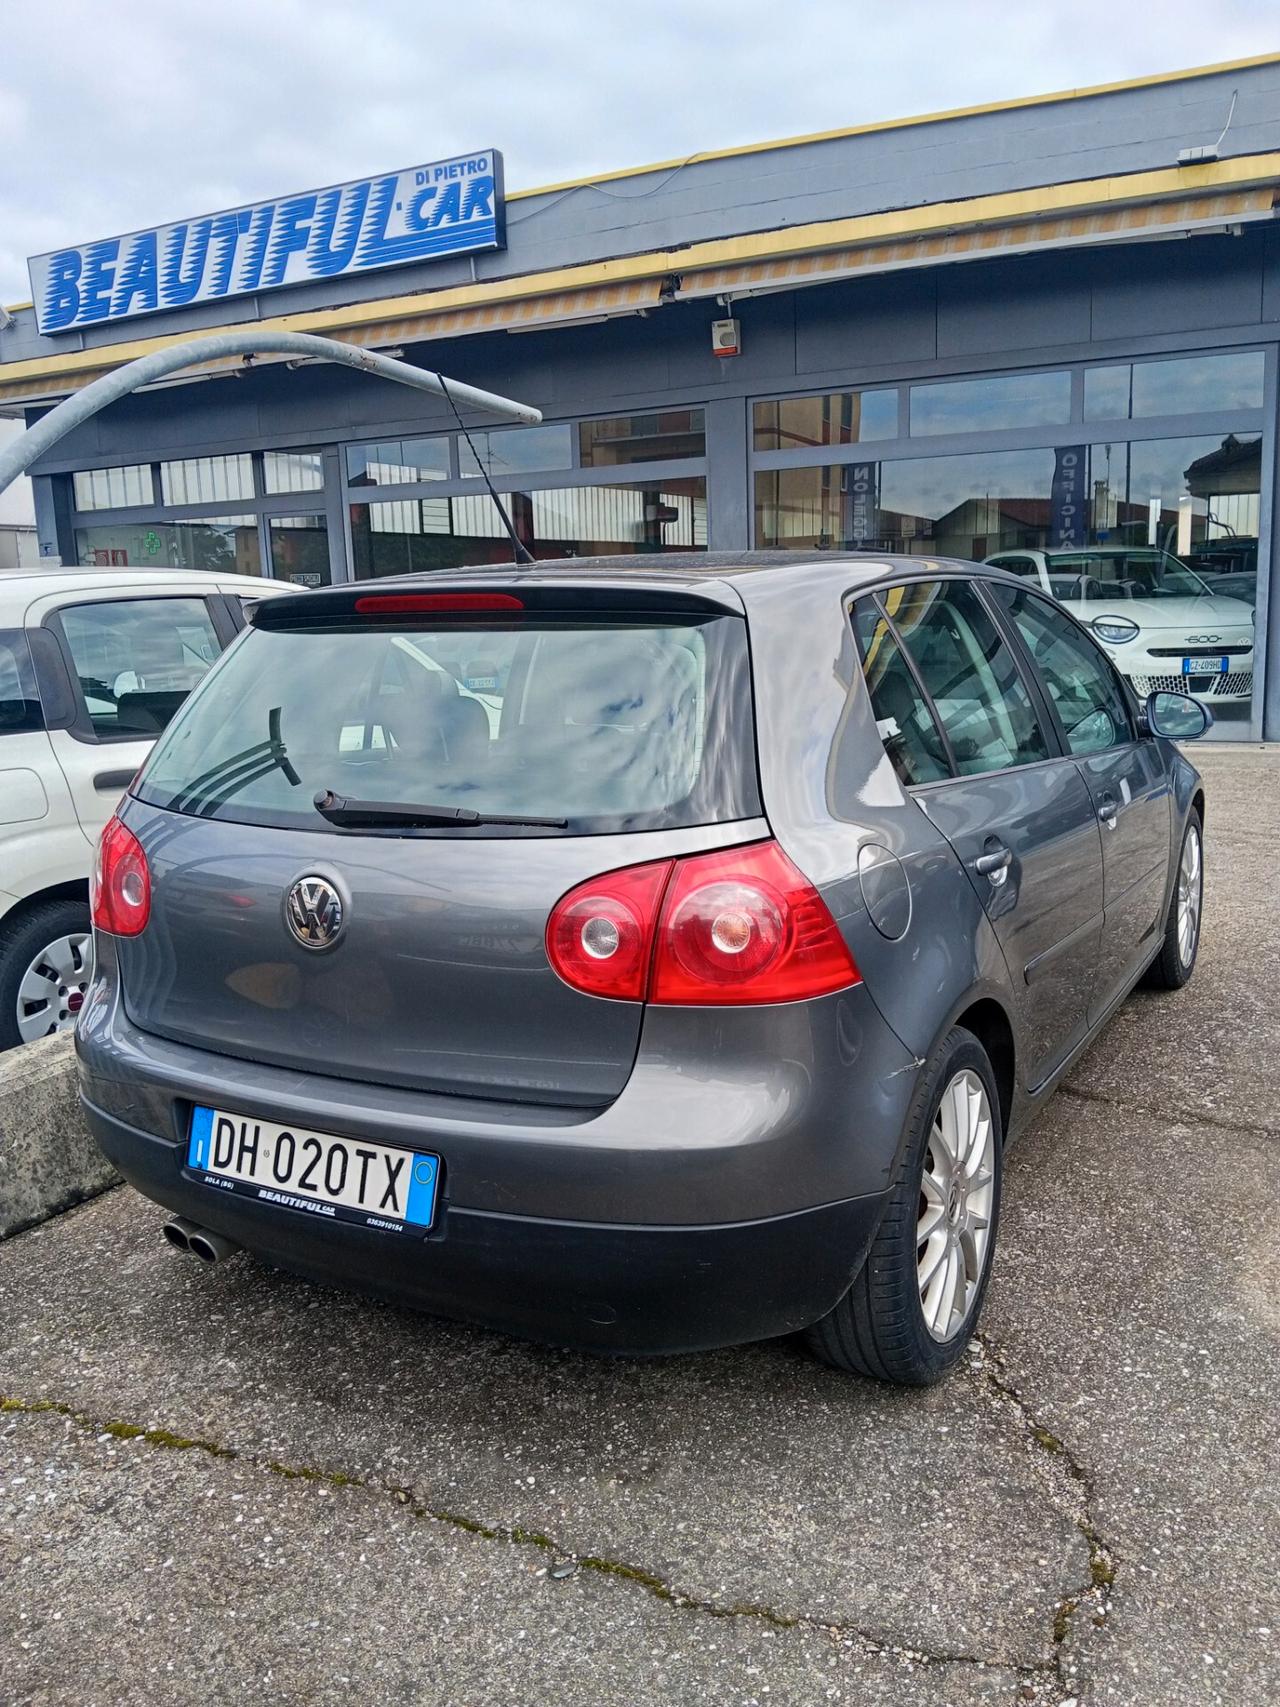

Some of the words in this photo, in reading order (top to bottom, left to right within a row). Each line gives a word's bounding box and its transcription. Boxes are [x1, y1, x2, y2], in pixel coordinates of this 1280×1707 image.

[416, 170, 430, 186] DI
[434, 158, 488, 182] PIETRO
[41, 175, 495, 330] BEAUTIFUL
[404, 175, 494, 231] CAR
[258, 1189, 335, 1216] BEAUTIFUL
